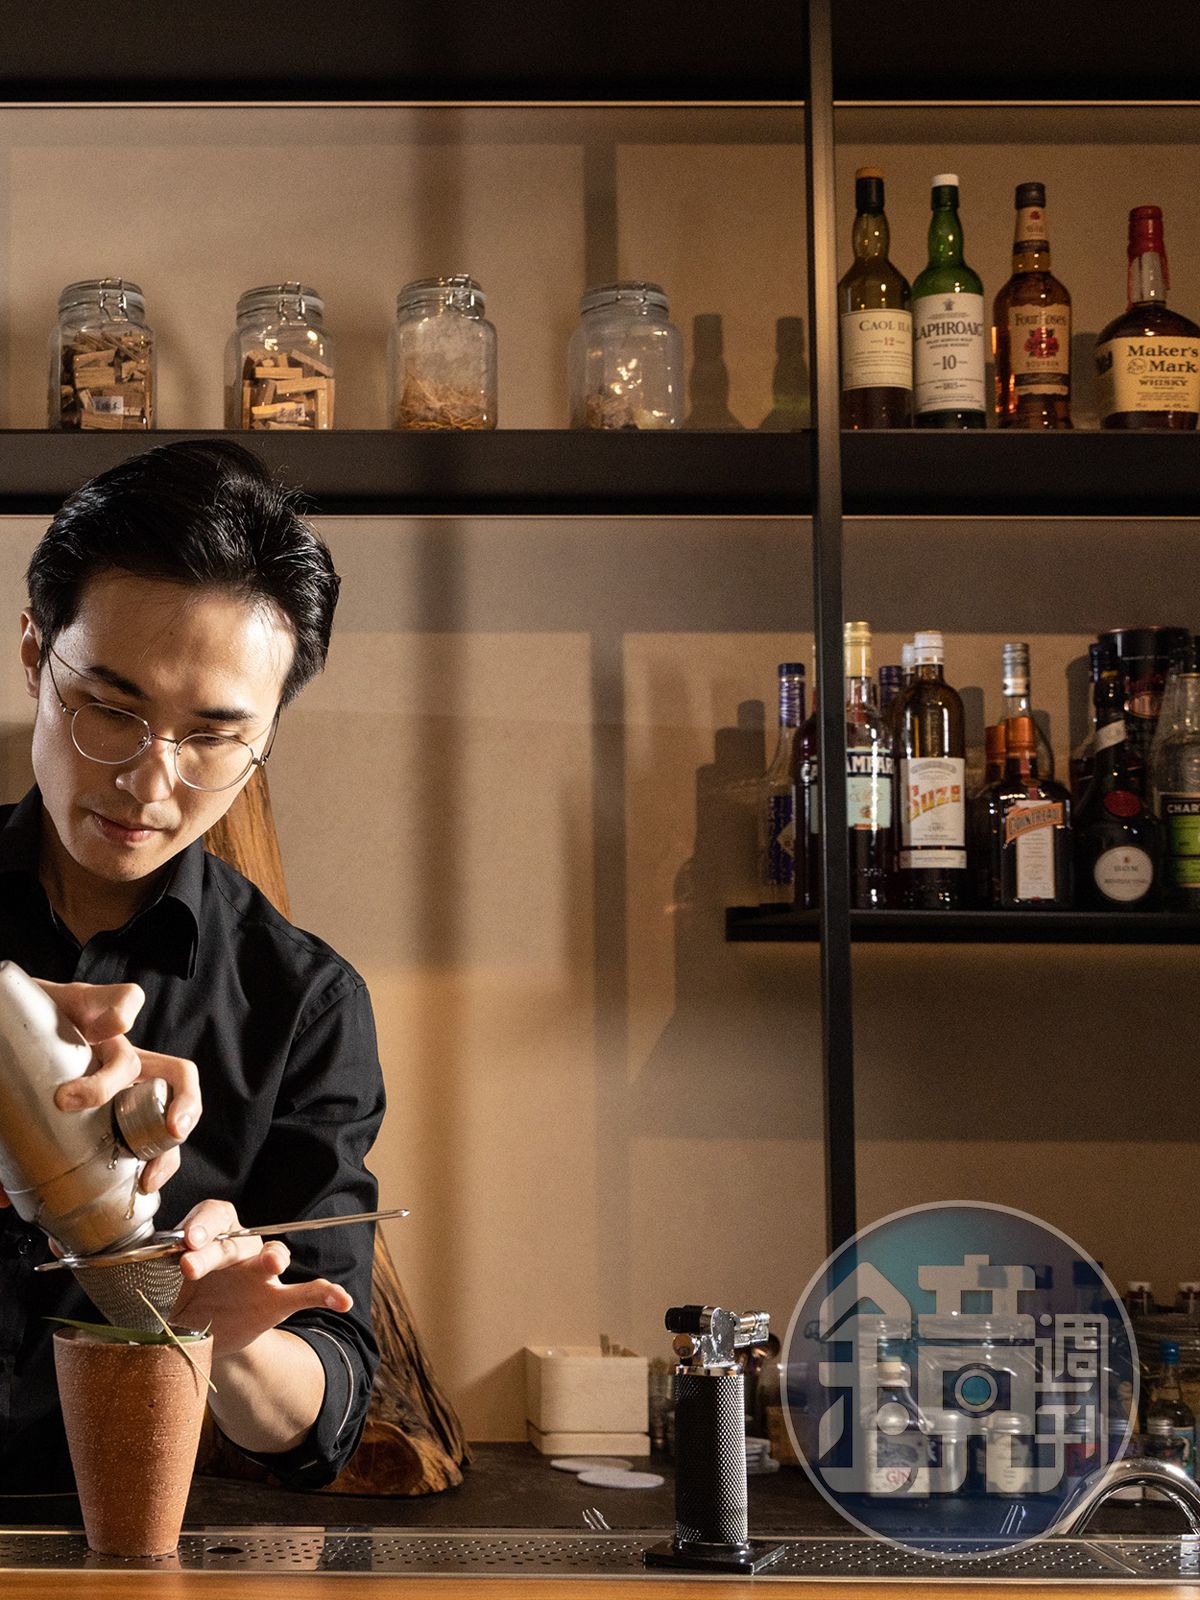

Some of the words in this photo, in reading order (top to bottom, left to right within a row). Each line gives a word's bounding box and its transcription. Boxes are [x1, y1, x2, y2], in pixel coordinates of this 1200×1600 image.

[859, 320, 898, 332] CAOL
[1127, 344, 1200, 360] Maker's
[942, 354, 957, 370] 10
[1148, 359, 1200, 375] Mark
